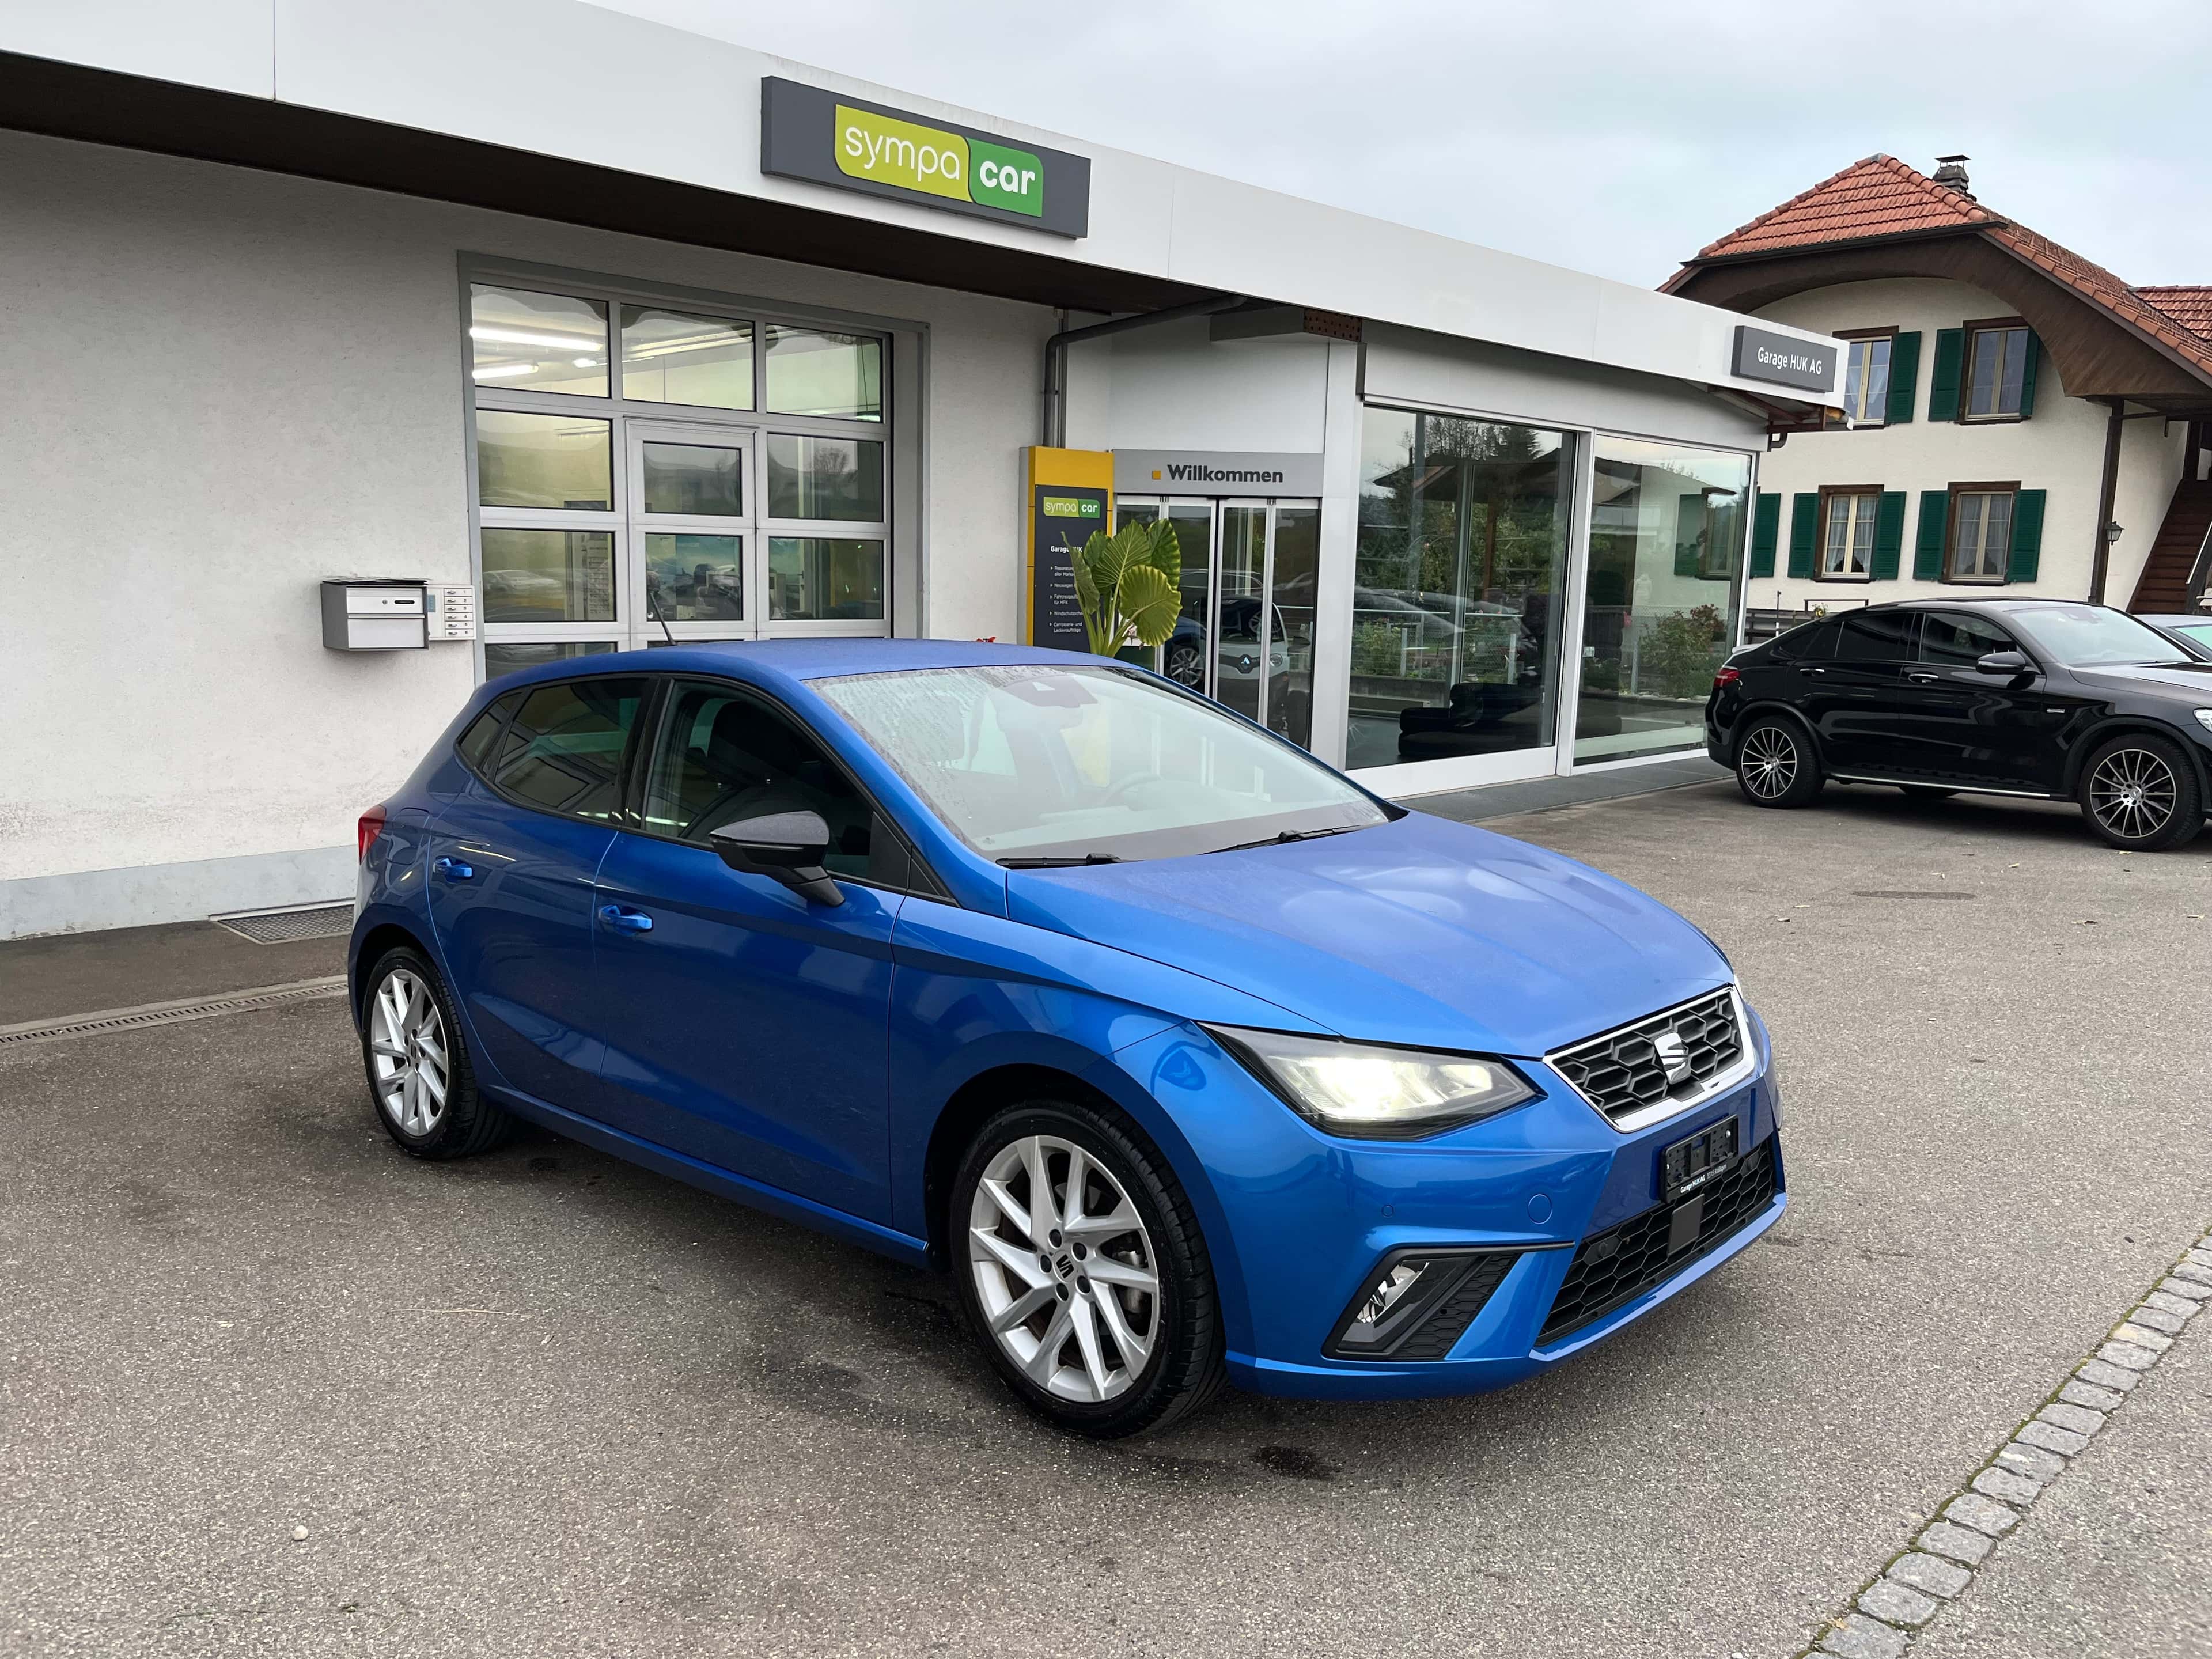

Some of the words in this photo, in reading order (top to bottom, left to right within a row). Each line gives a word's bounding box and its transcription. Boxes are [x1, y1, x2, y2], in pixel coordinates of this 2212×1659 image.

[844, 126, 960, 181] sympa
[979, 160, 1035, 195] car
[1758, 347, 1788, 369] Garage
[1790, 354, 1808, 372] HUK
[1809, 359, 1822, 374] AG
[1167, 464, 1283, 483] Willkommen
[1046, 502, 1077, 514] sympa
[1081, 504, 1097, 513] car
[1680, 1183, 1692, 1194] Garage
